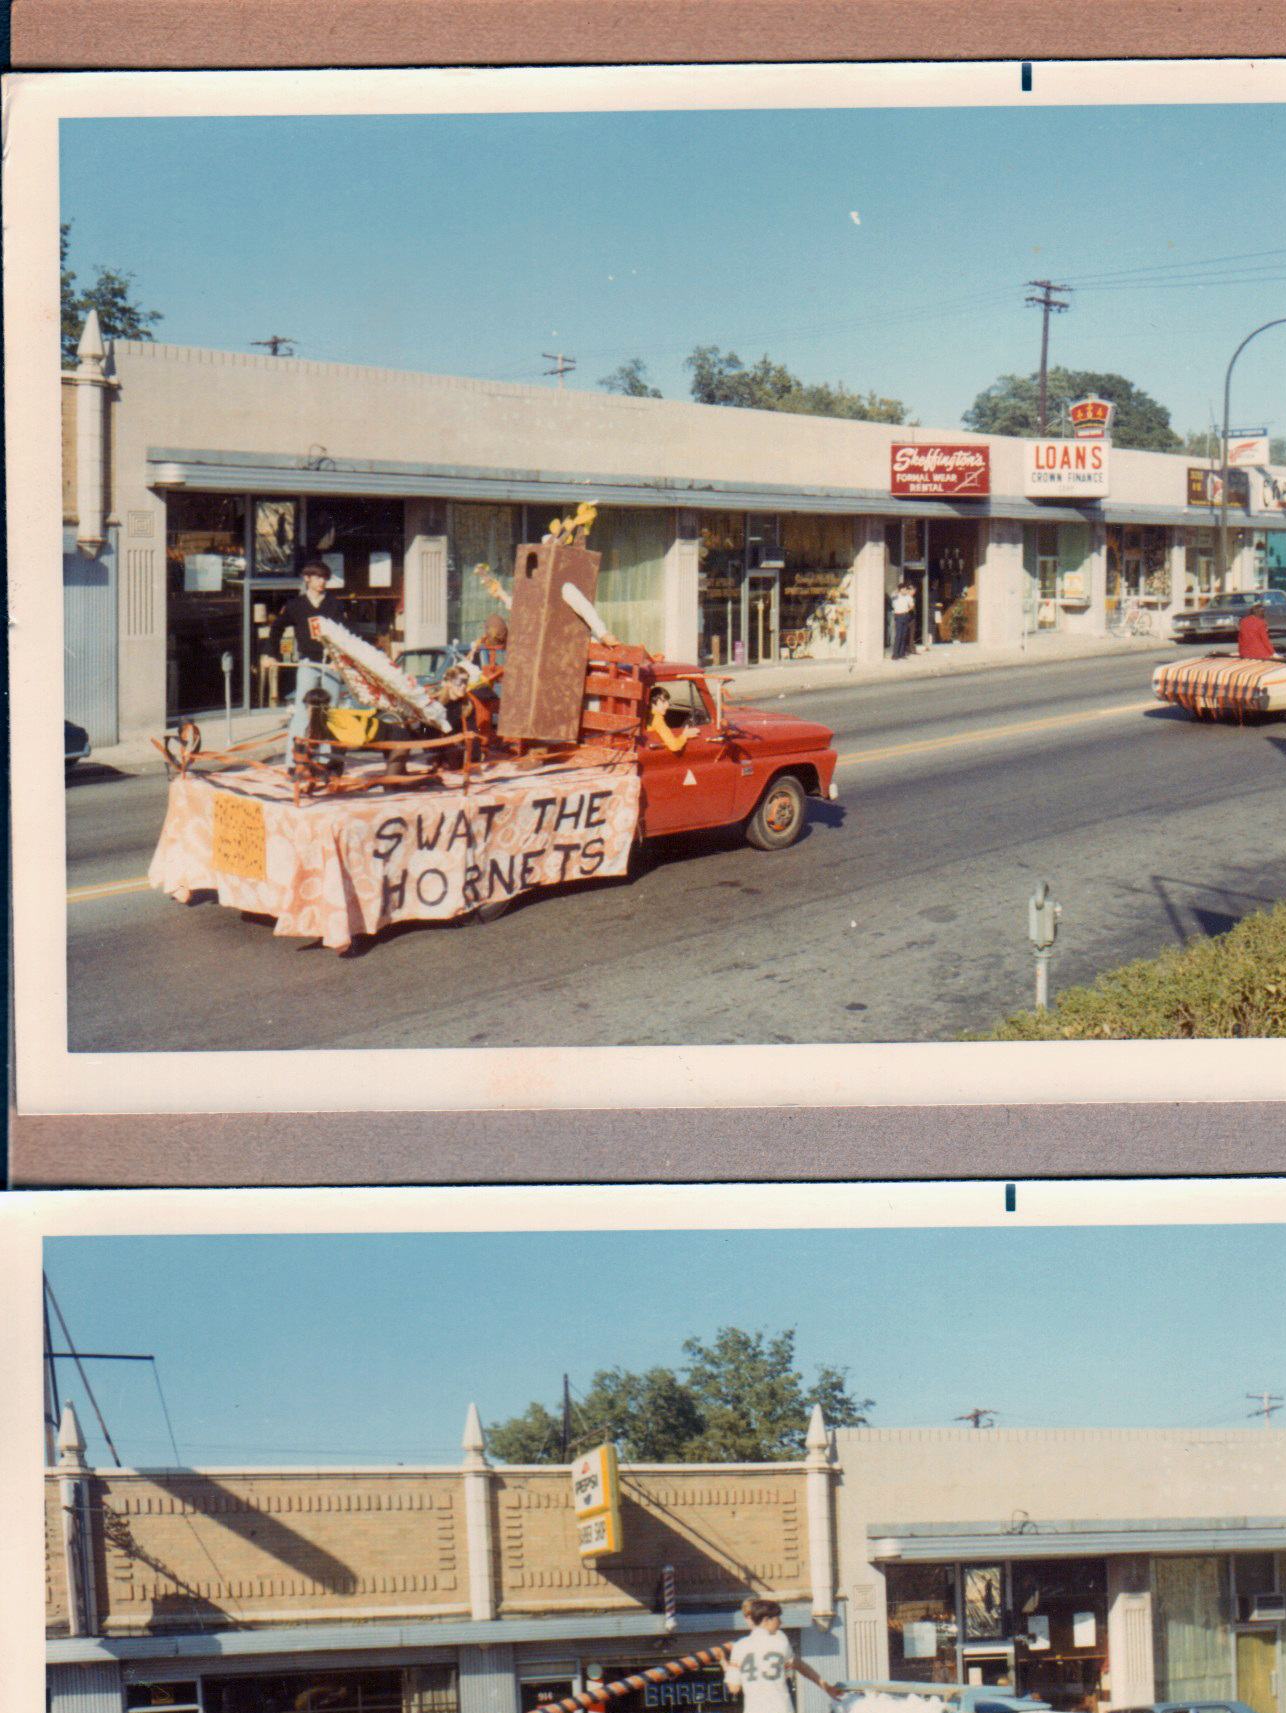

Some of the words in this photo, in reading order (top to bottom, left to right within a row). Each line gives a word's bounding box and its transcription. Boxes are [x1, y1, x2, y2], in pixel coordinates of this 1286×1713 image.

[1035, 446, 1102, 469] LOANS
[896, 474, 930, 483] FORMAL
[933, 473, 957, 482] WEAR
[910, 484, 944, 492] RENTAL
[1031, 472, 1062, 482] CROWN
[1068, 472, 1103, 482] FINANCE
[373, 803, 504, 859] SWAT
[533, 790, 613, 834] THE
[381, 837, 605, 912] HORNETS
[740, 1652, 785, 1682] 43
